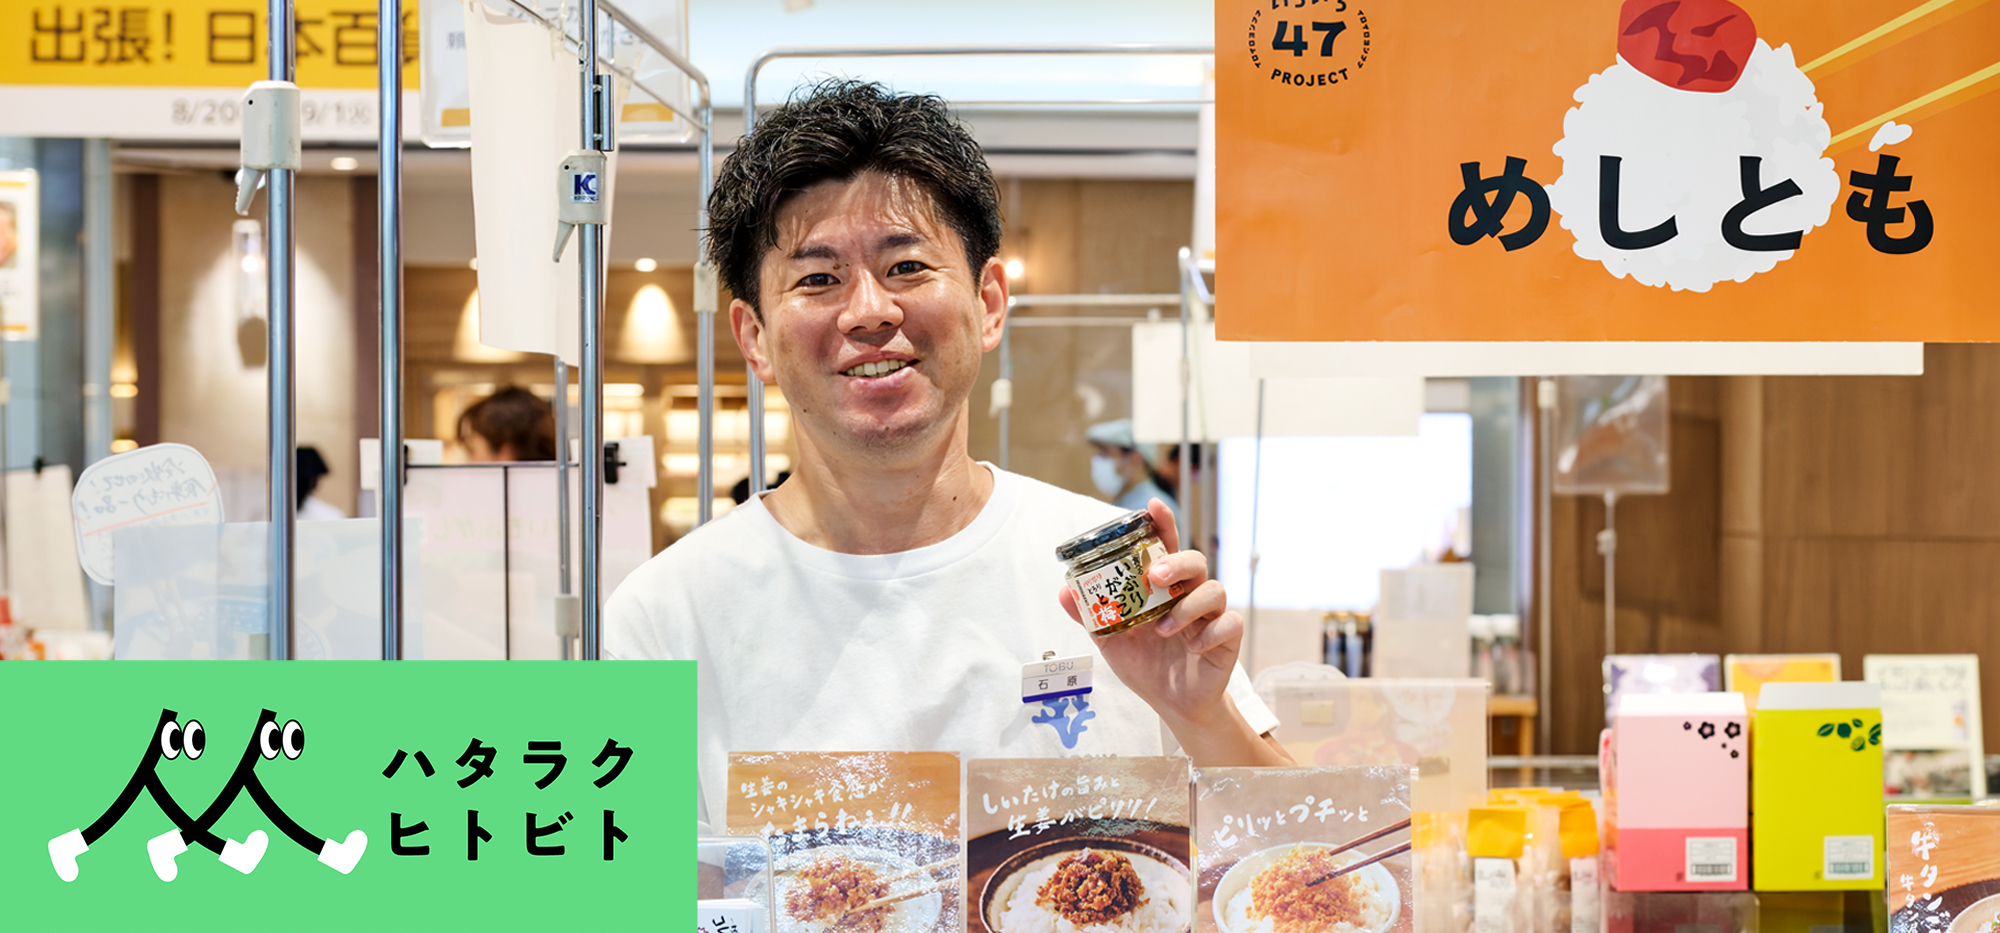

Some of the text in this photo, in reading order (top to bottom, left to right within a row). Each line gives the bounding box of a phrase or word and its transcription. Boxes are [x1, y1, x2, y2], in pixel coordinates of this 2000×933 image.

[30, 7, 176, 64] 出張!
[1272, 21, 1347, 57] 47
[1271, 68, 1348, 87] PROJECT
[1448, 154, 1935, 255] めしとも
[1044, 661, 1074, 673] TOBU
[982, 774, 1120, 815] しいたけの旨みと
[1214, 795, 1369, 848] ピリッとプチッと
